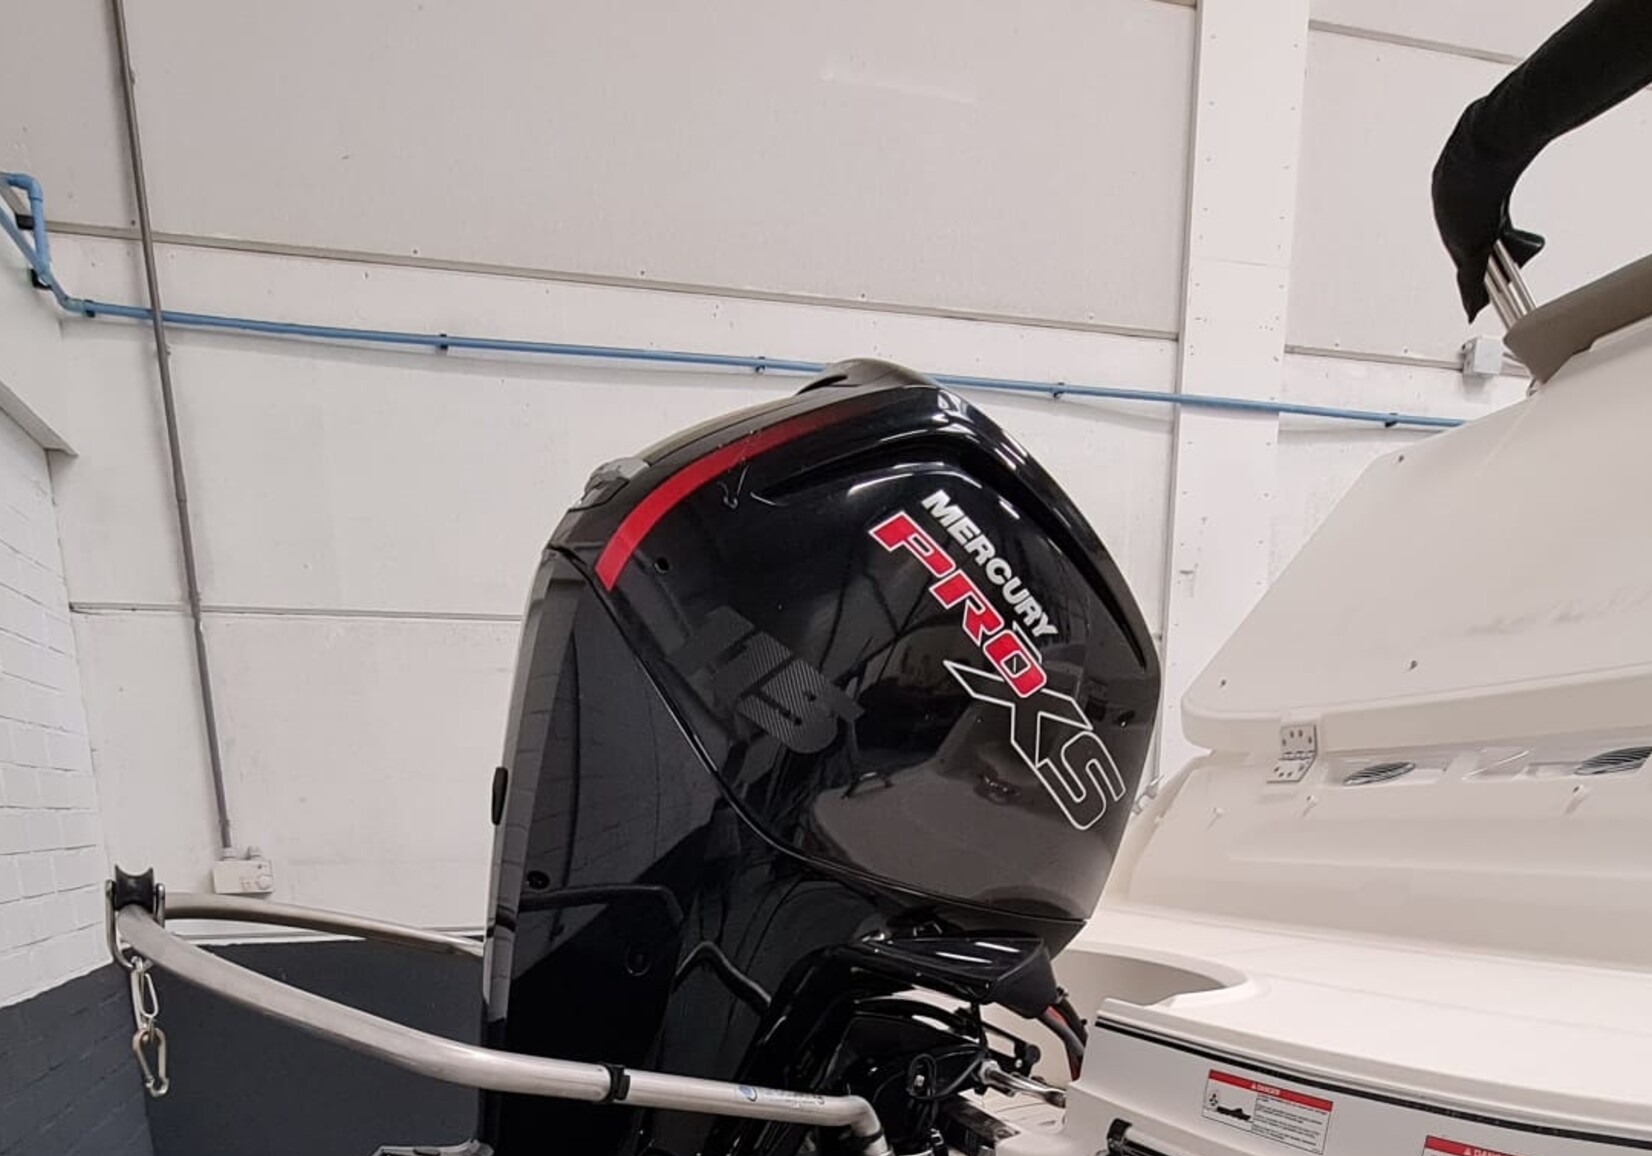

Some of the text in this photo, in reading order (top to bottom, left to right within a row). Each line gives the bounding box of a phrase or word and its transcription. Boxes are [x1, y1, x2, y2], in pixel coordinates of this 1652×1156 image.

[869, 511, 1126, 830] PRO XS
[920, 489, 1058, 637] MERCURY
